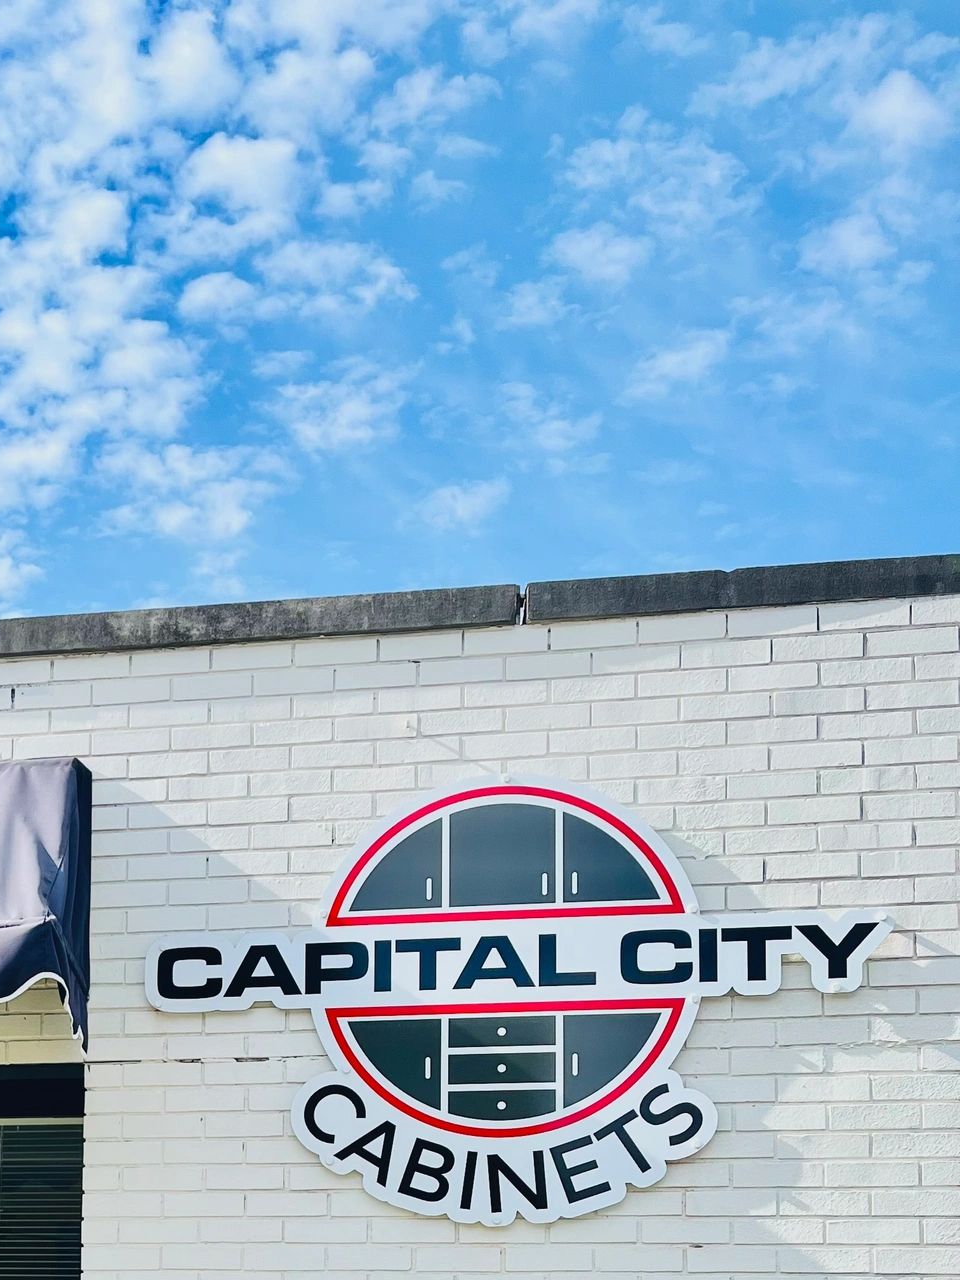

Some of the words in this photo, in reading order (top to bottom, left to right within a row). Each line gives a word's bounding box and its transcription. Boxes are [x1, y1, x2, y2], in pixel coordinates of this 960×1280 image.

[157, 934, 596, 999] CAPITAL
[619, 922, 880, 985] CITY
[303, 1083, 704, 1213] CABINETS
